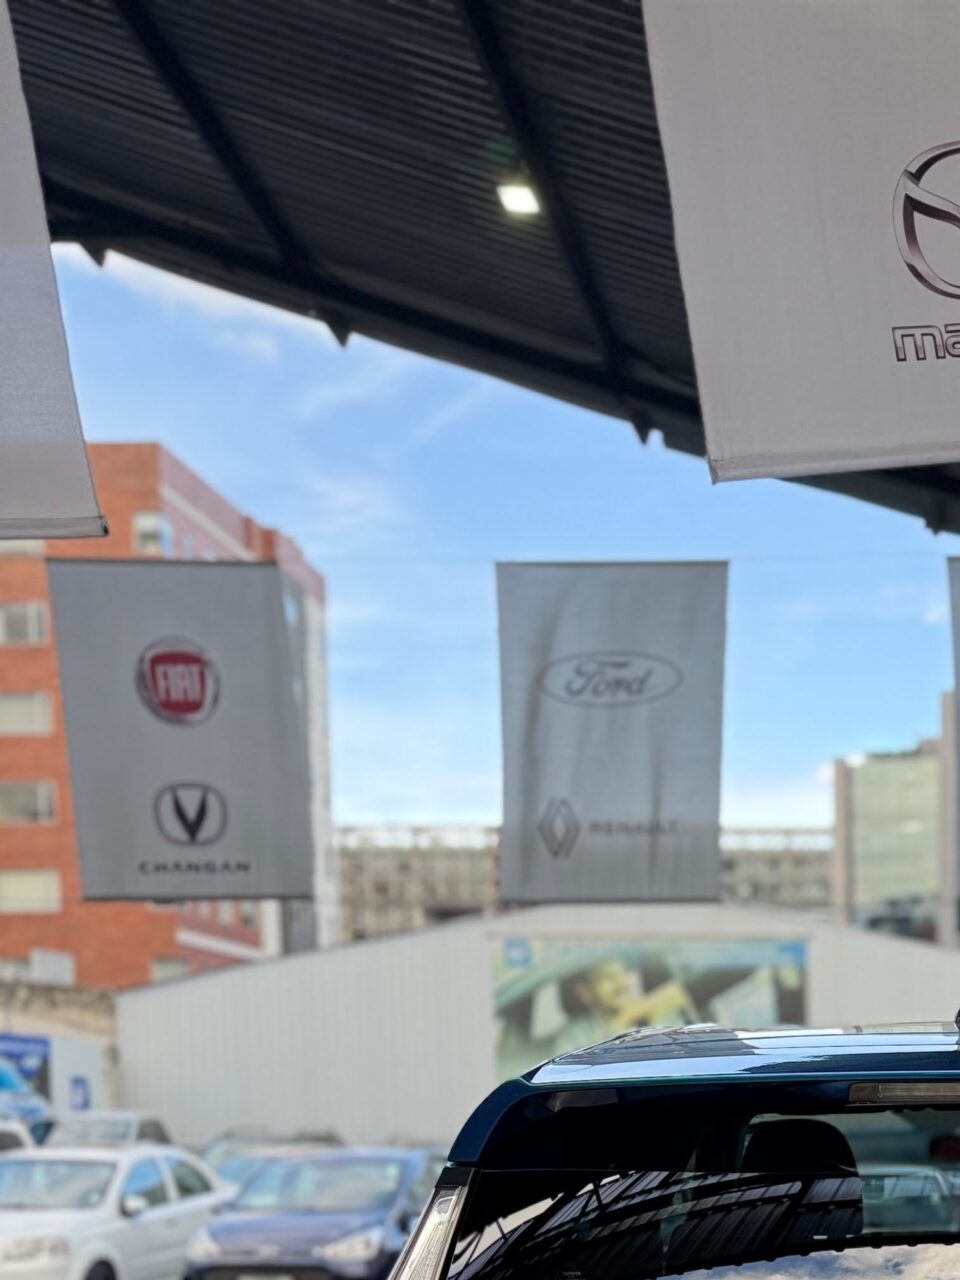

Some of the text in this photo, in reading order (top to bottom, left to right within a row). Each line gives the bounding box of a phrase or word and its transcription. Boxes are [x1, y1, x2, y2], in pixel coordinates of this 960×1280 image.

[155, 662, 202, 703] FIAT
[565, 660, 655, 697] Ford
[138, 860, 251, 876] CHANGAN
